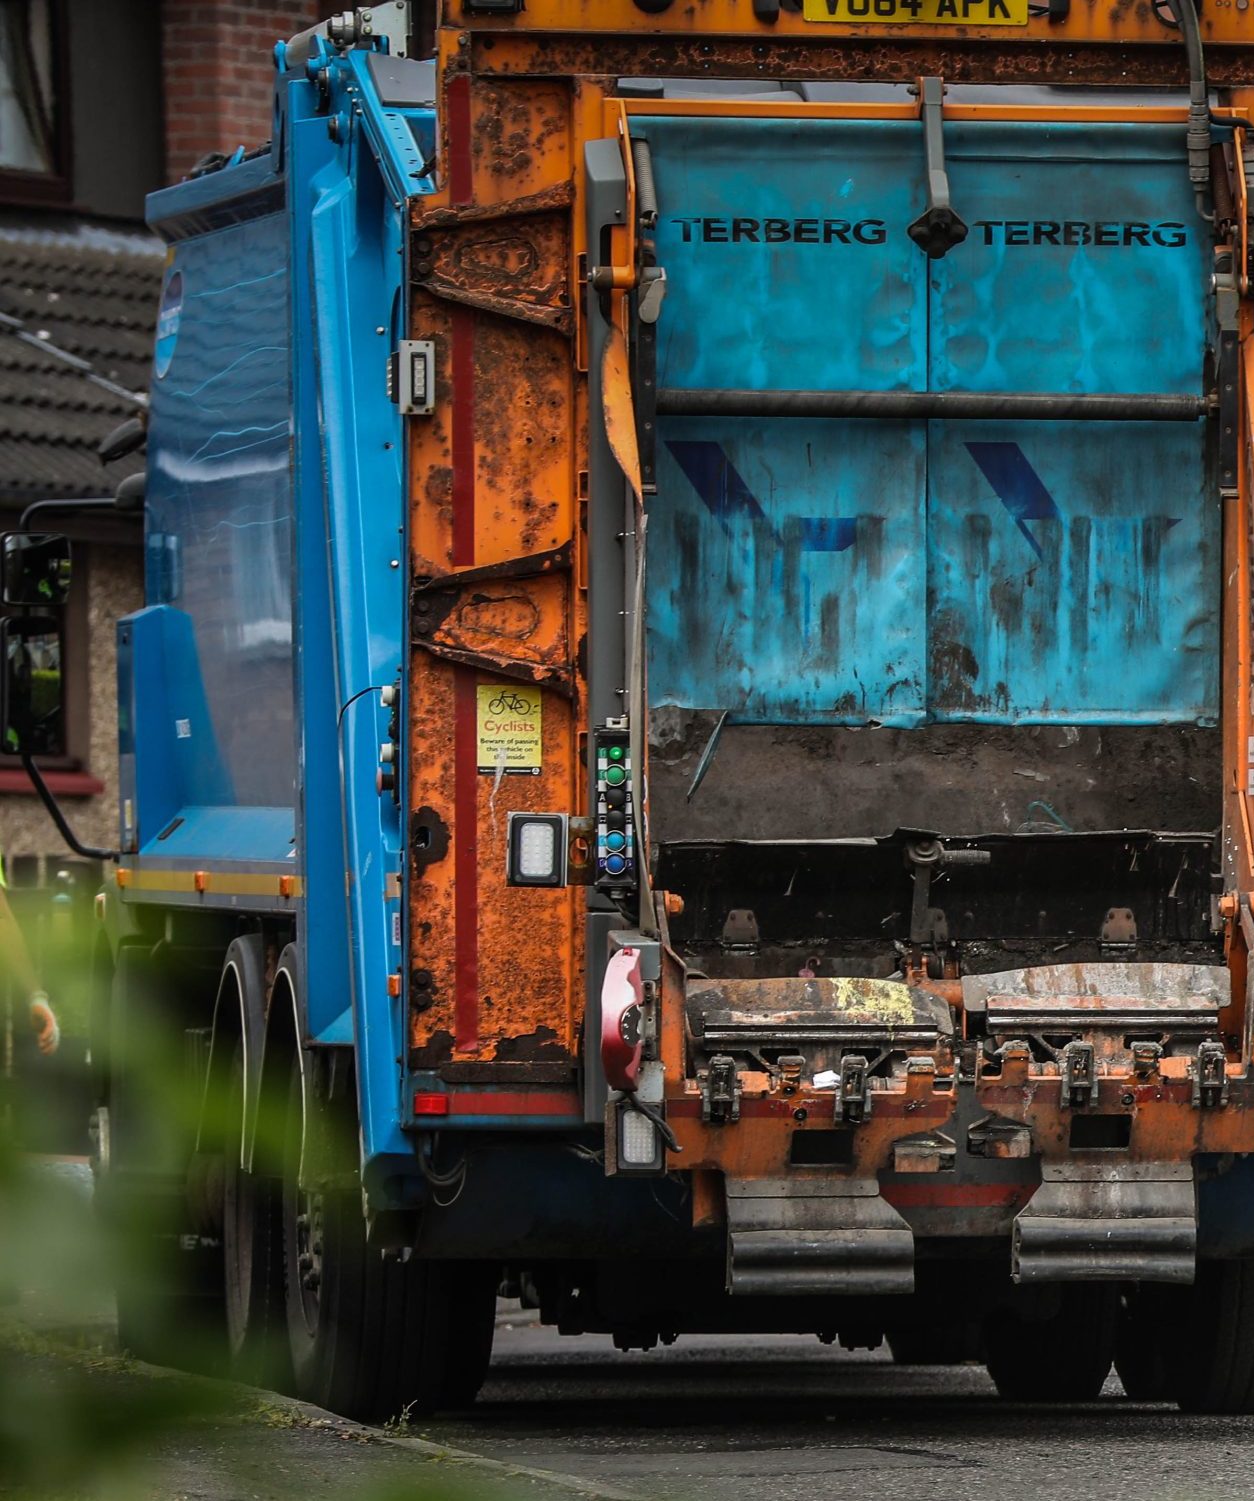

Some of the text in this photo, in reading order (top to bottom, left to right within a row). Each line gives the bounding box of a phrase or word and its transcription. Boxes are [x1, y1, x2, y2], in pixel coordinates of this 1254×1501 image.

[936, 0, 1011, 18] APK
[670, 217, 887, 245] TERBERG
[972, 221, 1187, 247] TERBERG
[484, 720, 535, 734] Cyclists
[515, 738, 539, 746] passing
[599, 793, 606, 801] A
